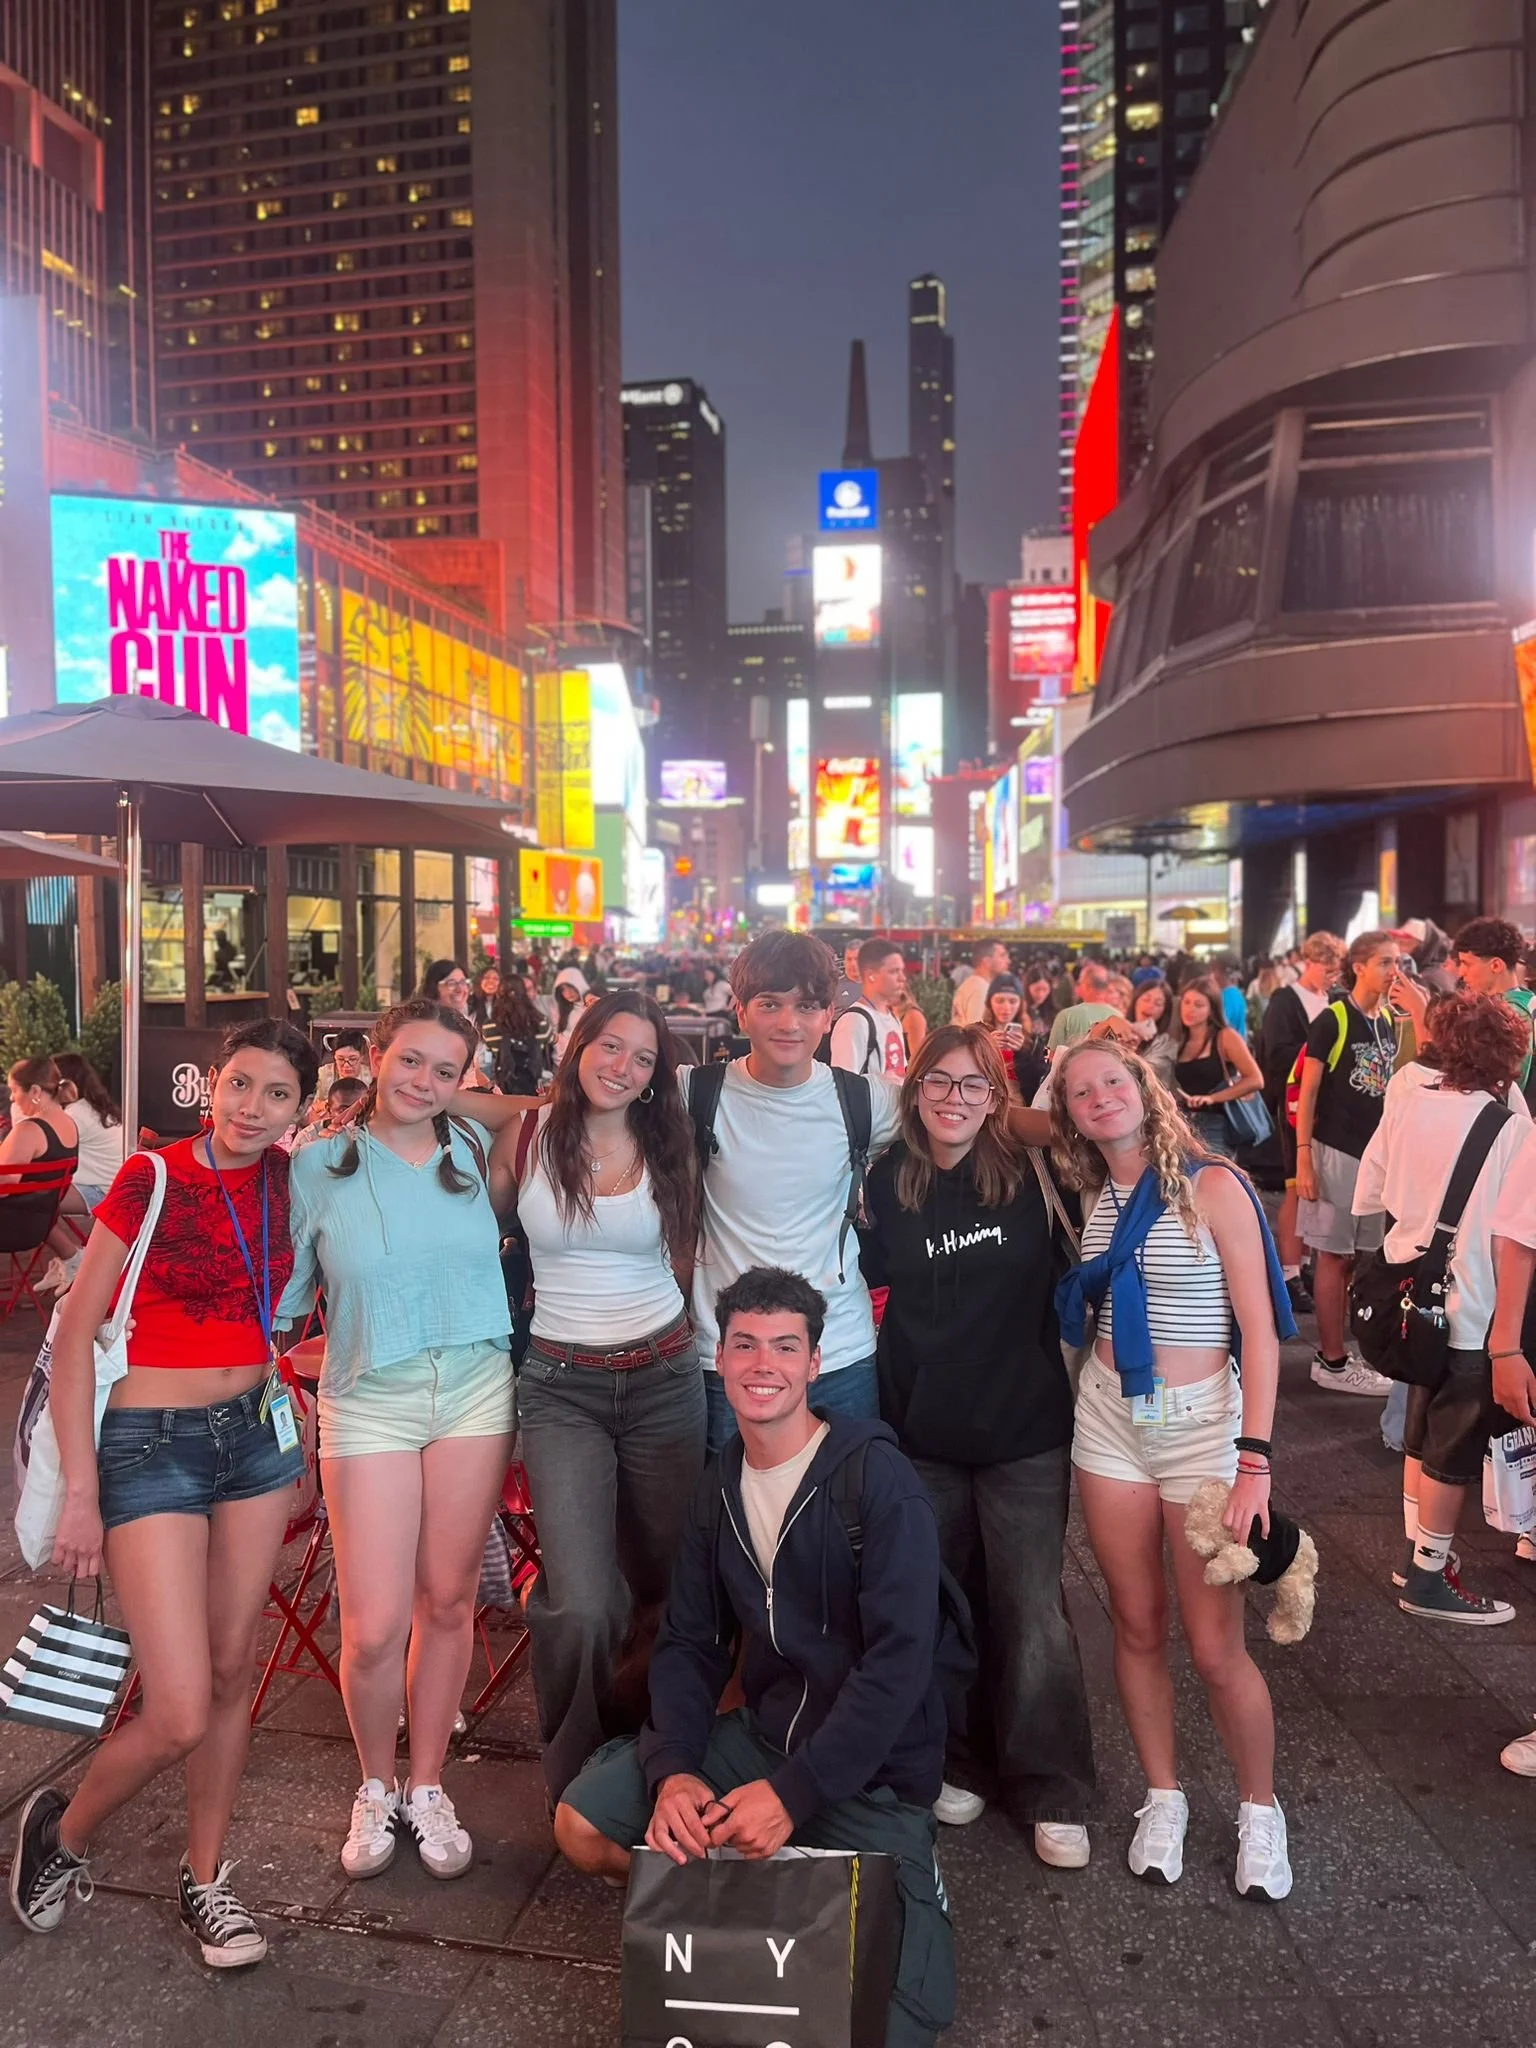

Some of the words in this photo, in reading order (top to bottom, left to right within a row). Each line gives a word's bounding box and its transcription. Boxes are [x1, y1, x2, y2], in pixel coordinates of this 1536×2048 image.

[160, 531, 190, 561] THE
[108, 557, 246, 635] NAKED
[110, 630, 249, 737] GUN
[665, 1932, 693, 1974] N
[766, 1937, 796, 1979] Y
